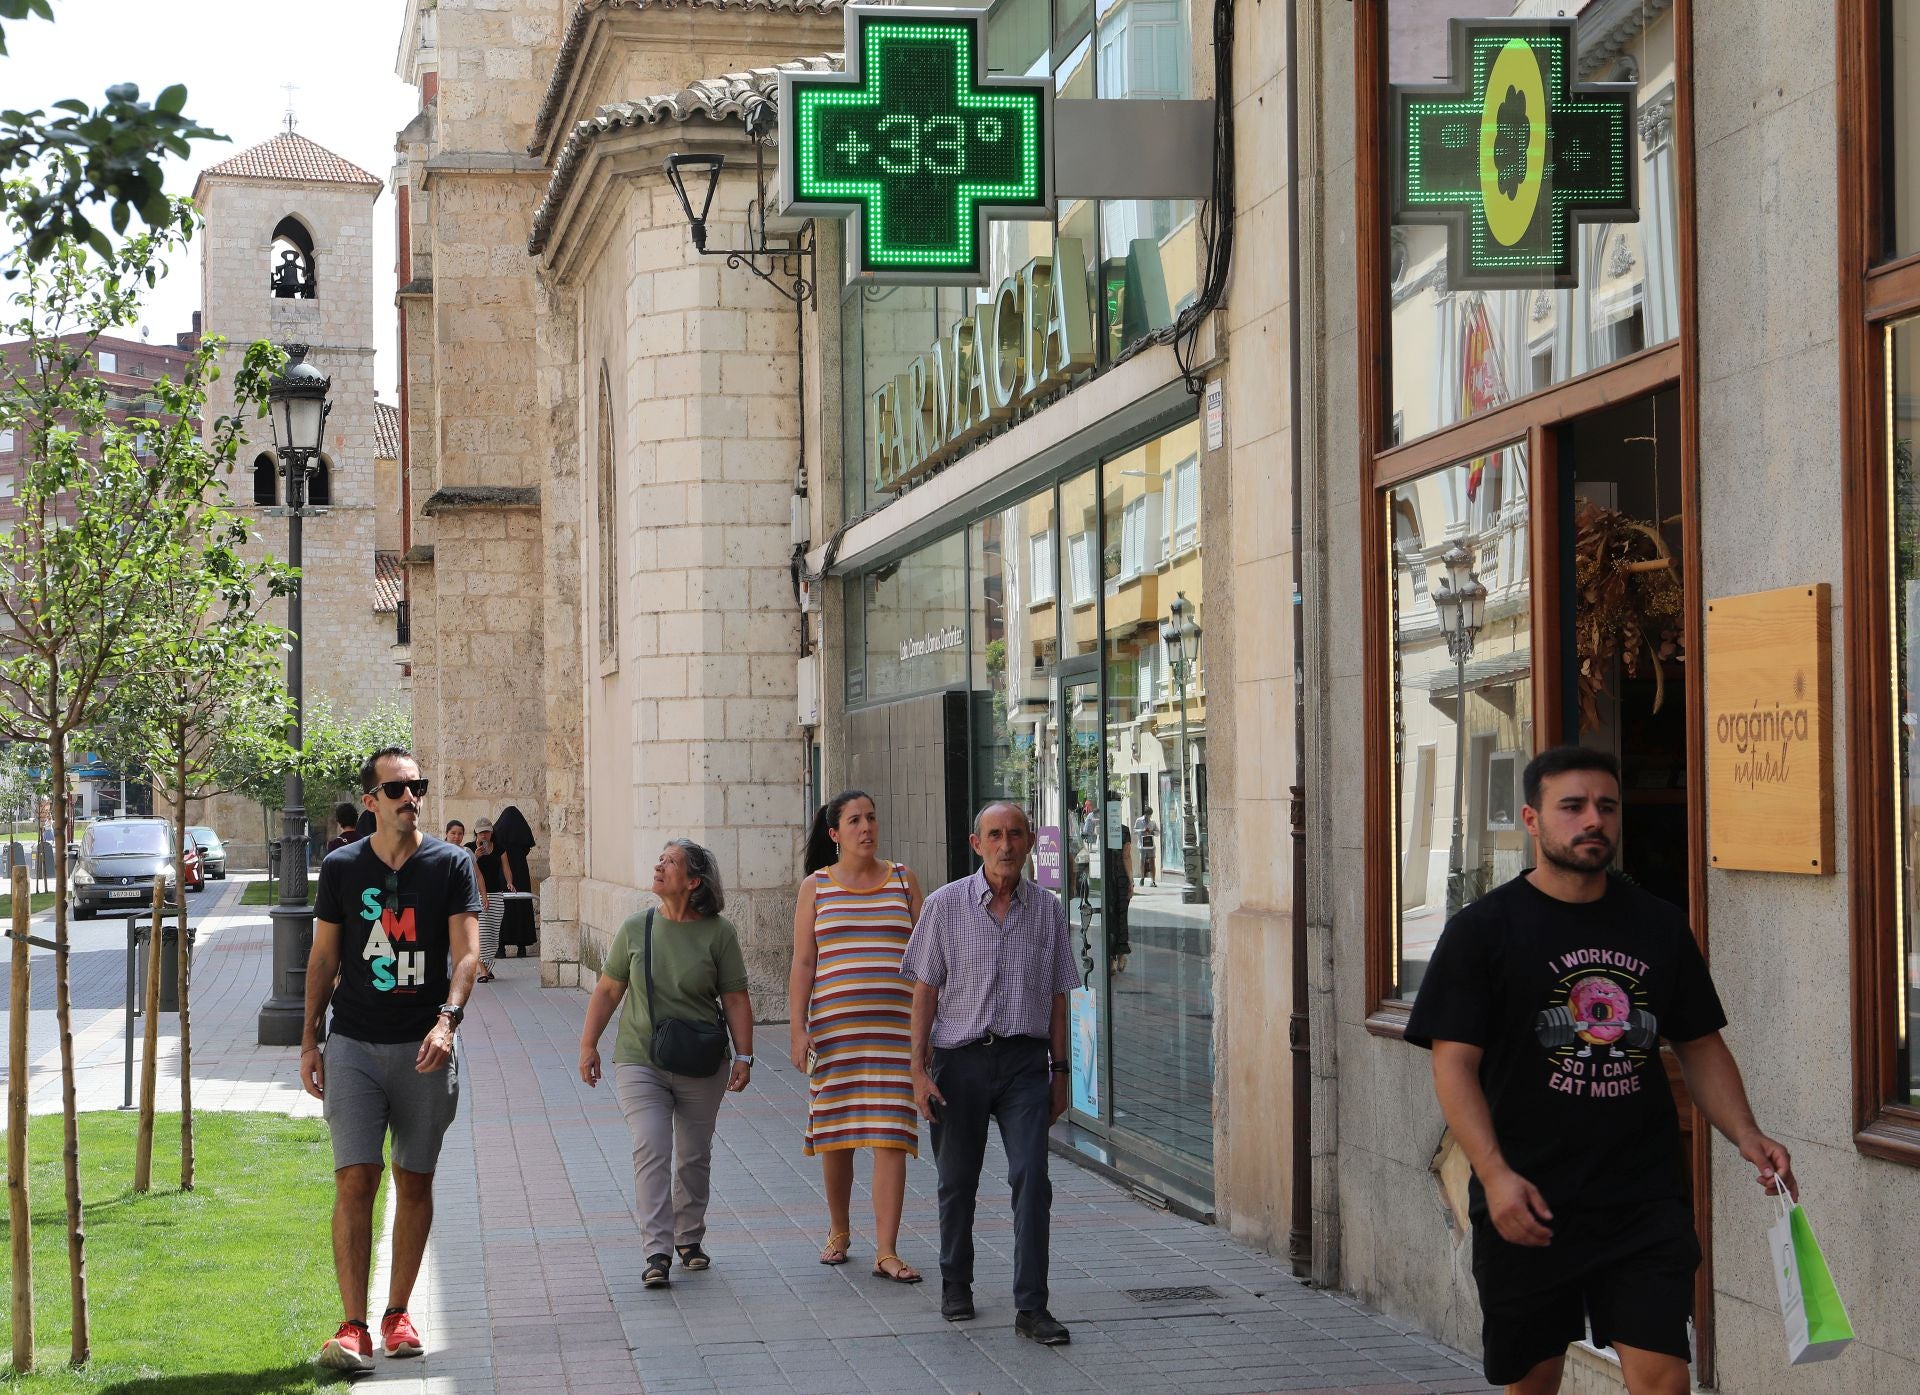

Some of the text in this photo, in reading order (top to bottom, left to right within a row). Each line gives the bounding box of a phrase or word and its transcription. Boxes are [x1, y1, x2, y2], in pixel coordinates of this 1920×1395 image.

[872, 237, 1074, 493] FARMACIA
[1716, 699, 1809, 754] orgánica
[1734, 740, 1790, 790] natural
[1548, 948, 1650, 977] I WORKOUT
[1548, 1072, 1641, 1098] EAT MORE
[1561, 1058, 1633, 1078] SO I CAN
